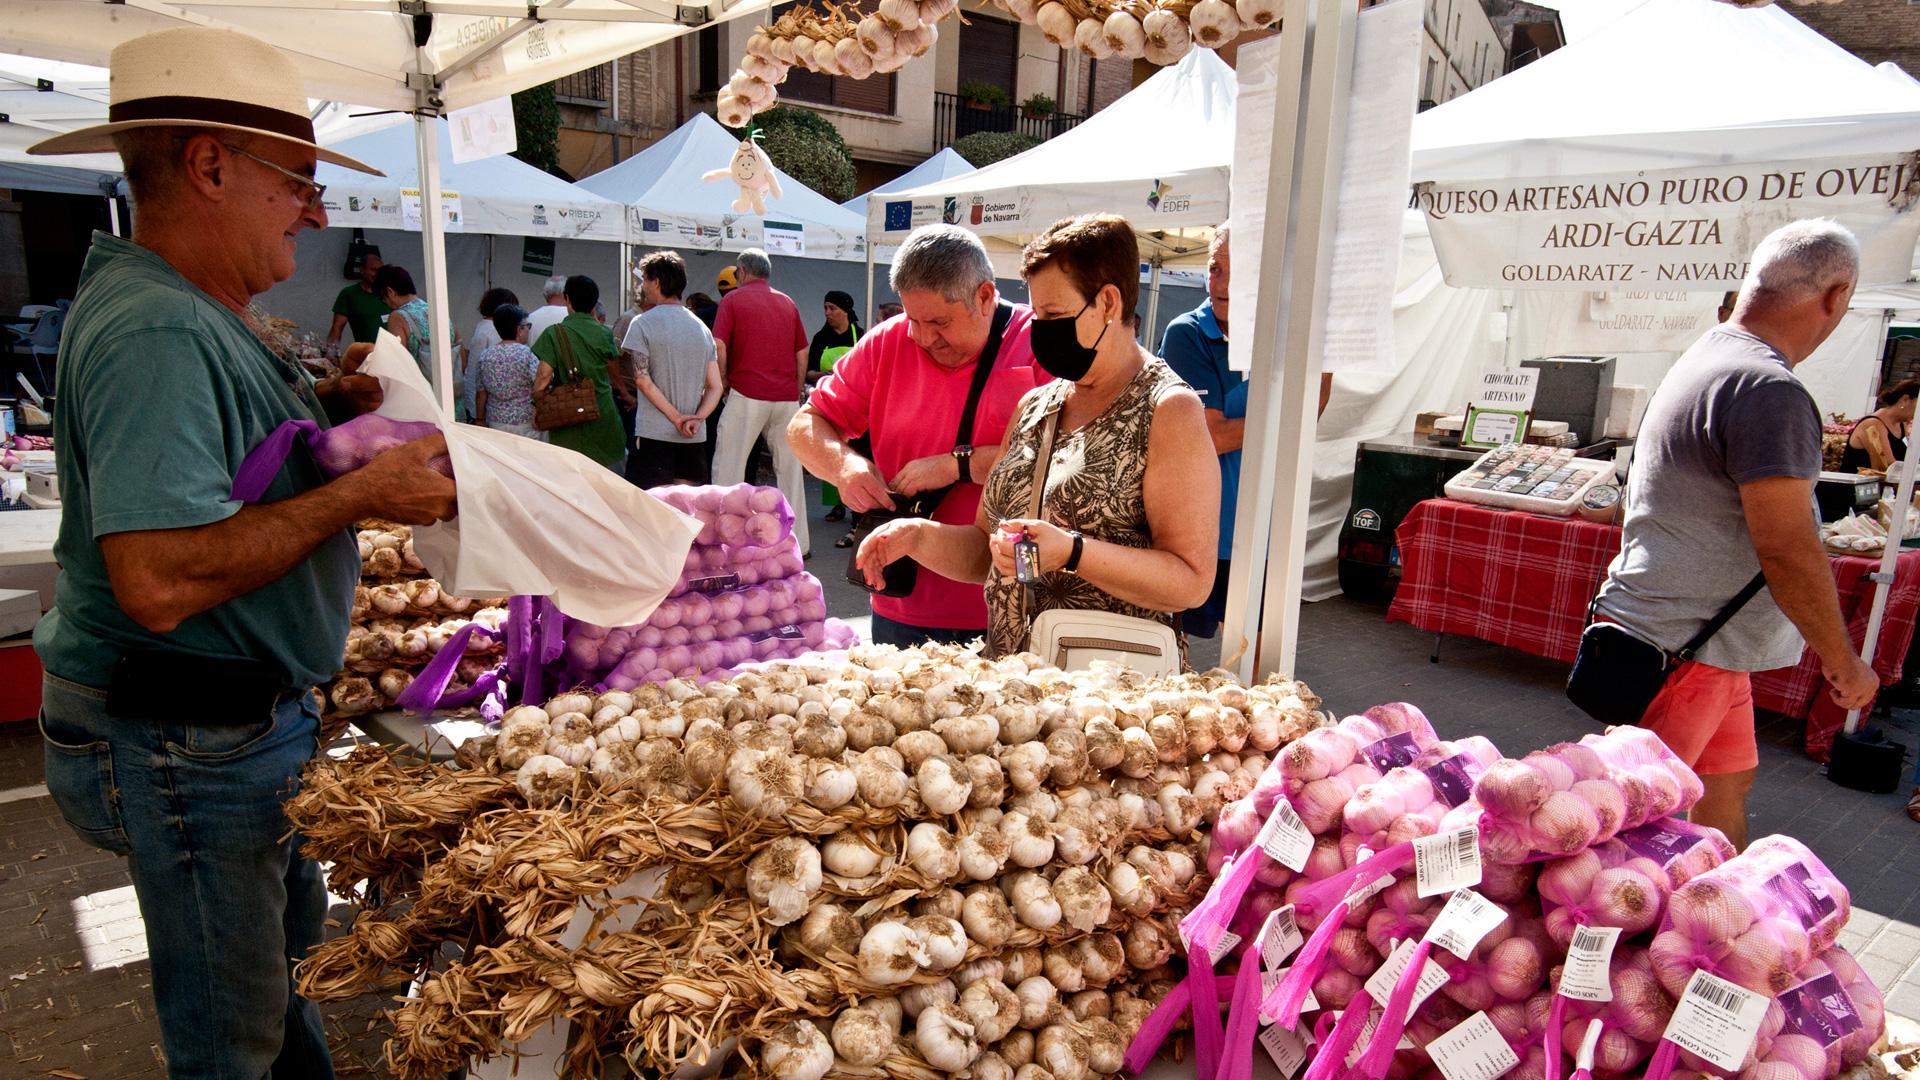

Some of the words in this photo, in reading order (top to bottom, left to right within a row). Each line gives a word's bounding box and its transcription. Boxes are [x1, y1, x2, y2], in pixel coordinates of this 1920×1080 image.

[1421, 189, 1498, 219] QUESO
[1504, 181, 1650, 212] ARTESANO
[1659, 176, 1748, 205] PURO
[1759, 171, 1805, 200] DE
[984, 203, 1015, 212] Gobierno
[1162, 200, 1190, 212] EDER
[568, 209, 601, 219] RIBERA
[993, 214, 1020, 222] Navarra
[1541, 218, 1723, 248] ARDI-GAZTA
[1501, 264, 1634, 281] GOLDARATZ
[1656, 262, 1752, 281] NAVAR
[1483, 373, 1531, 386] CHOCOLATE
[1481, 391, 1526, 403] ARTESANO
[1355, 517, 1374, 527] TOF
[1700, 1047, 1720, 1062] AJOS
